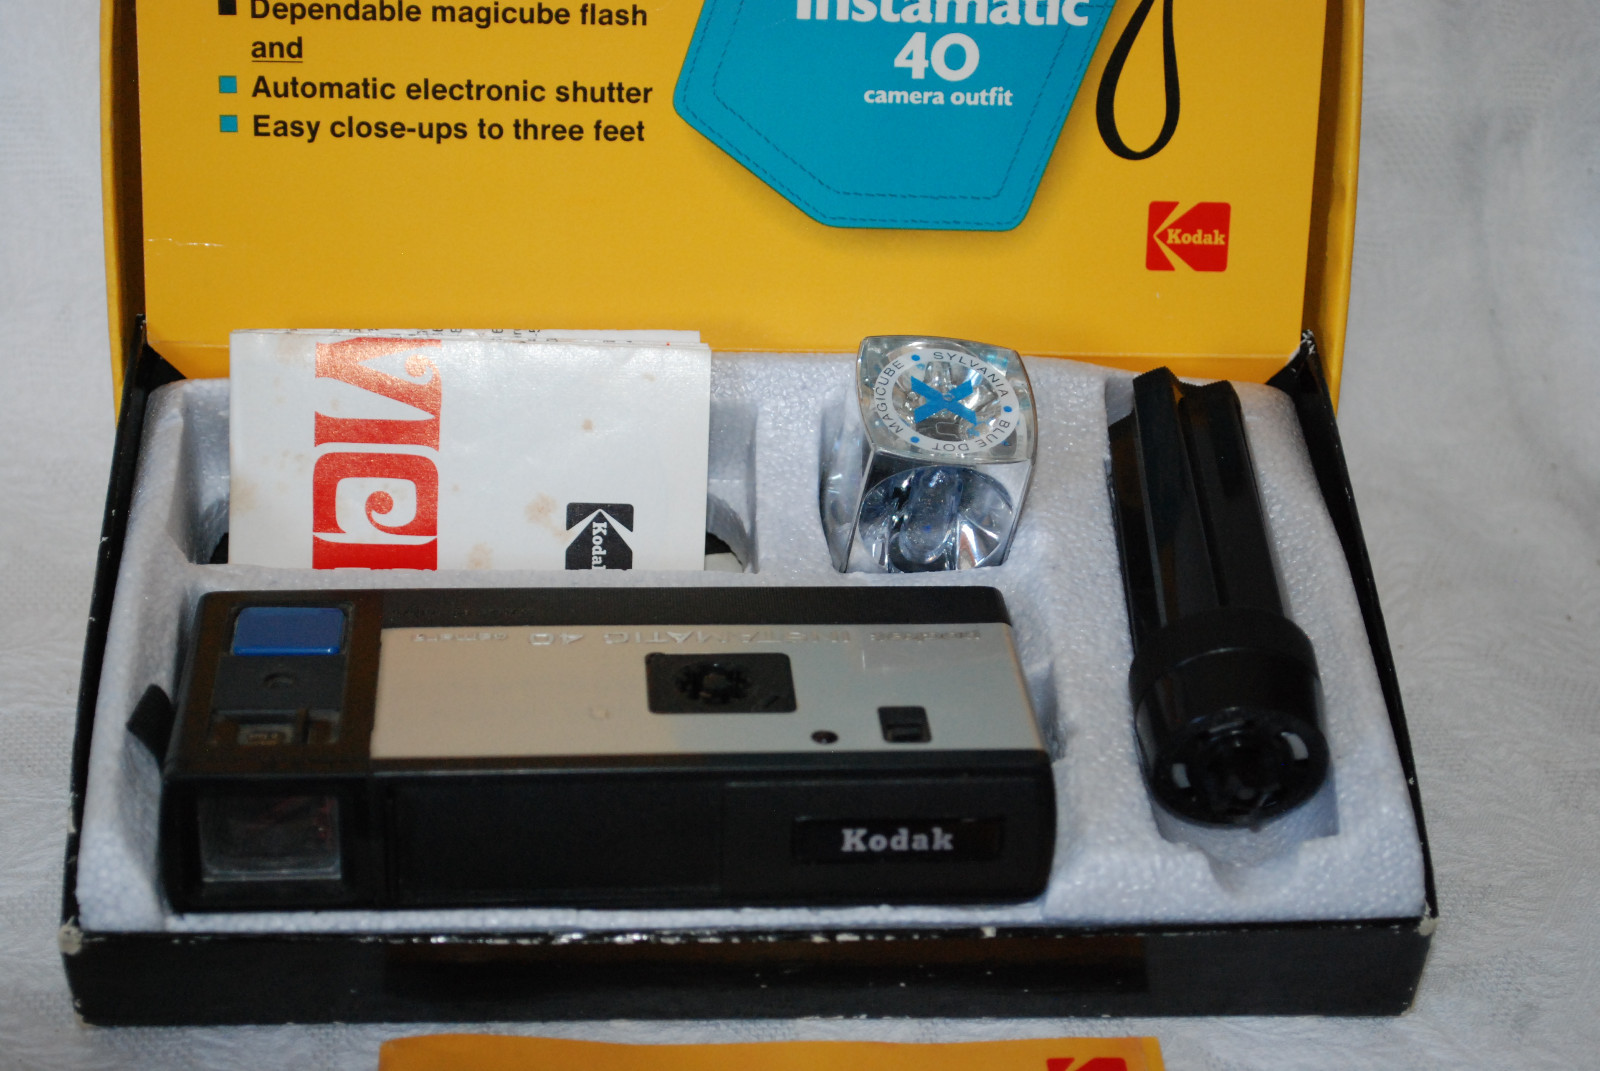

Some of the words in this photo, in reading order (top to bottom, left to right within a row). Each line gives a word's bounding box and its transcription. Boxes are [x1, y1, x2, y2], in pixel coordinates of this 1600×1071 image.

[250, 0, 422, 25] Dependable
[431, 0, 571, 29] magicube
[579, 3, 647, 26] flash
[251, 36, 303, 63] and
[894, 31, 980, 82] 40
[251, 76, 396, 100] Automatic
[405, 78, 546, 102] electronic
[555, 80, 653, 104] shutter
[863, 89, 945, 105] camera
[950, 86, 1014, 106] outfit
[253, 114, 321, 144] Easy
[329, 115, 468, 145] close-ups
[477, 118, 504, 140] to
[512, 118, 584, 141] three
[593, 119, 645, 142] feet
[1166, 228, 1226, 245] Kodak
[932, 351, 1009, 398] SYLVANIA
[876, 359, 905, 434] MAGICUBE
[931, 441, 970, 452] DOT
[974, 418, 1011, 448] BLUE
[841, 828, 953, 853] Kodak
